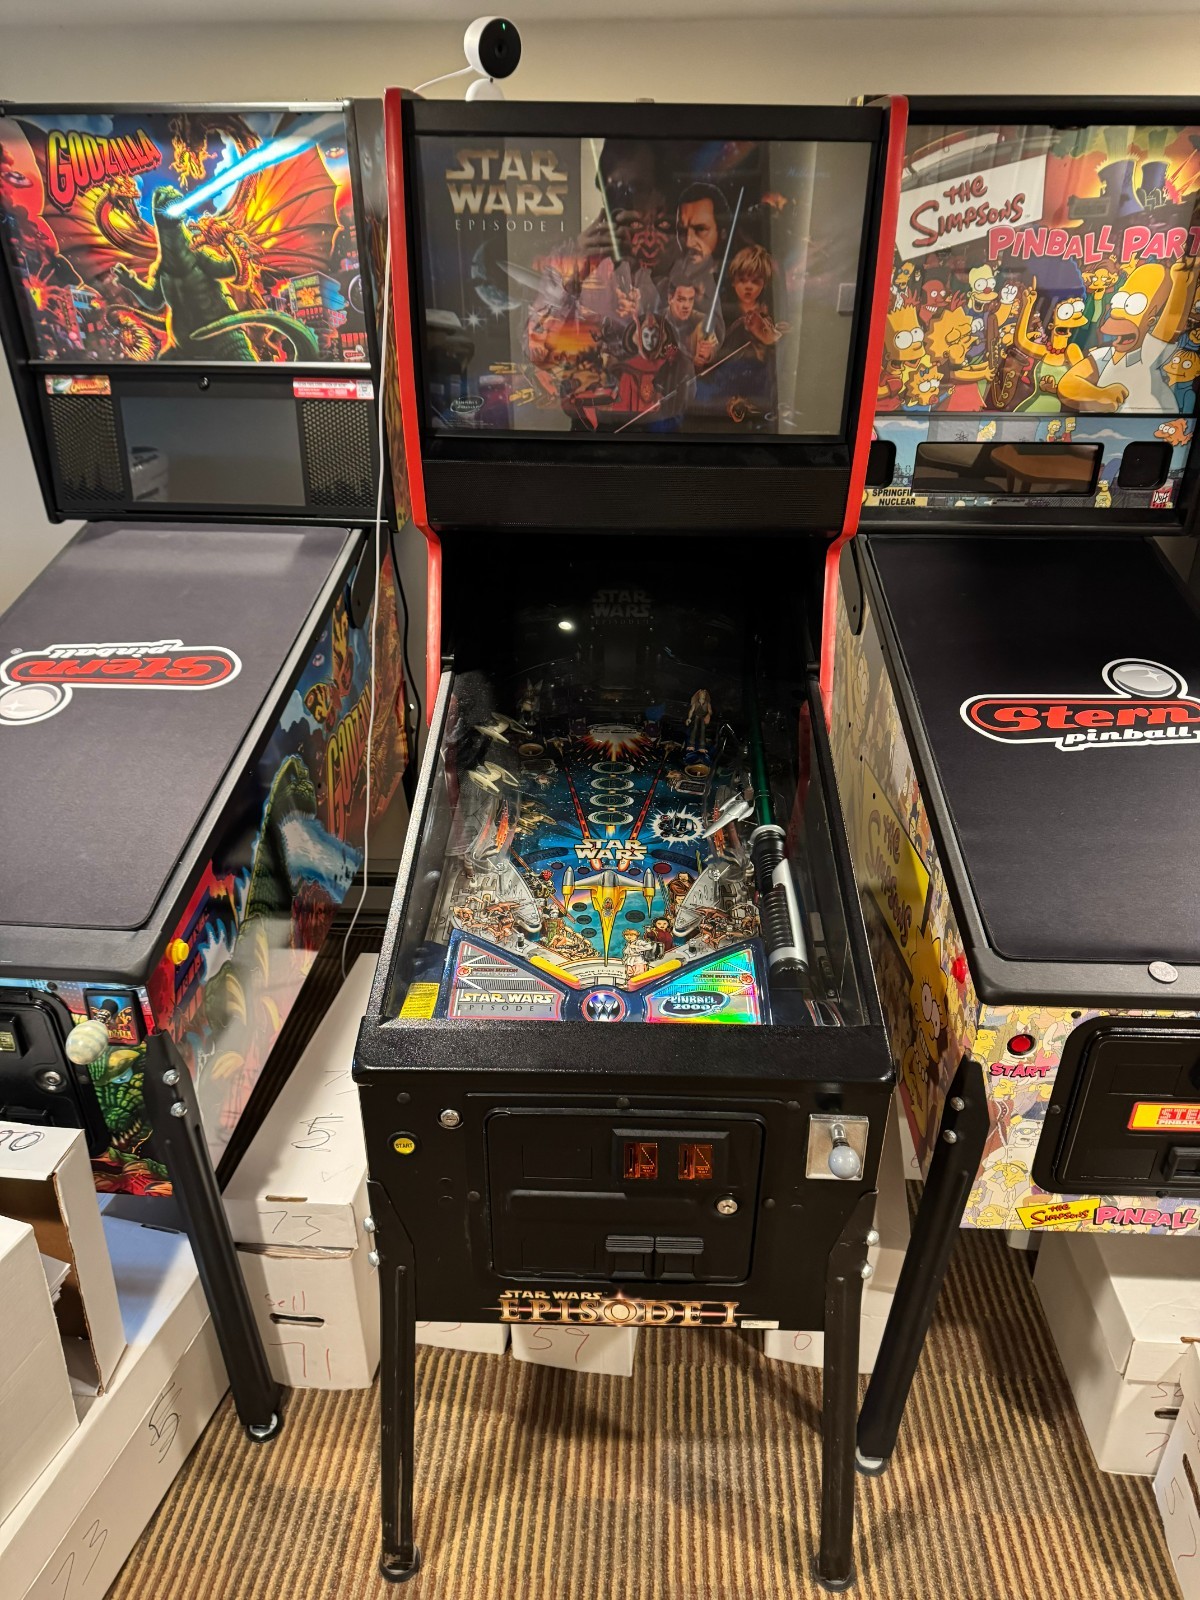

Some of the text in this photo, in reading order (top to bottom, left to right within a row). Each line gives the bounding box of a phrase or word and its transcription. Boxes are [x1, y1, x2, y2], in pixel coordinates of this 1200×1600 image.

[48, 128, 162, 209] GODZILLA
[445, 149, 568, 182] STAR
[446, 183, 568, 216] WARS
[455, 219, 546, 232] EPISODE
[988, 225, 1115, 264] PINBALL
[878, 498, 916, 506] NUCLEAR
[47, 643, 173, 659] pinball
[28, 655, 212, 679] Stern
[993, 705, 1200, 732] Stern
[1064, 726, 1192, 745] pinball
[574, 838, 648, 850] STAR
[574, 848, 648, 861] WARS
[458, 993, 555, 1004] STAR WARS
[669, 993, 718, 1004] PINBALL
[457, 1004, 535, 1012] EPISODE
[990, 1063, 1051, 1078] START
[1158, 1108, 1200, 1120] STE
[1094, 1205, 1198, 1230] PINBALL
[500, 1290, 603, 1300] STAR WARS
[499, 1299, 741, 1326] EPISODE I
[527, 1326, 590, 1364] 59
